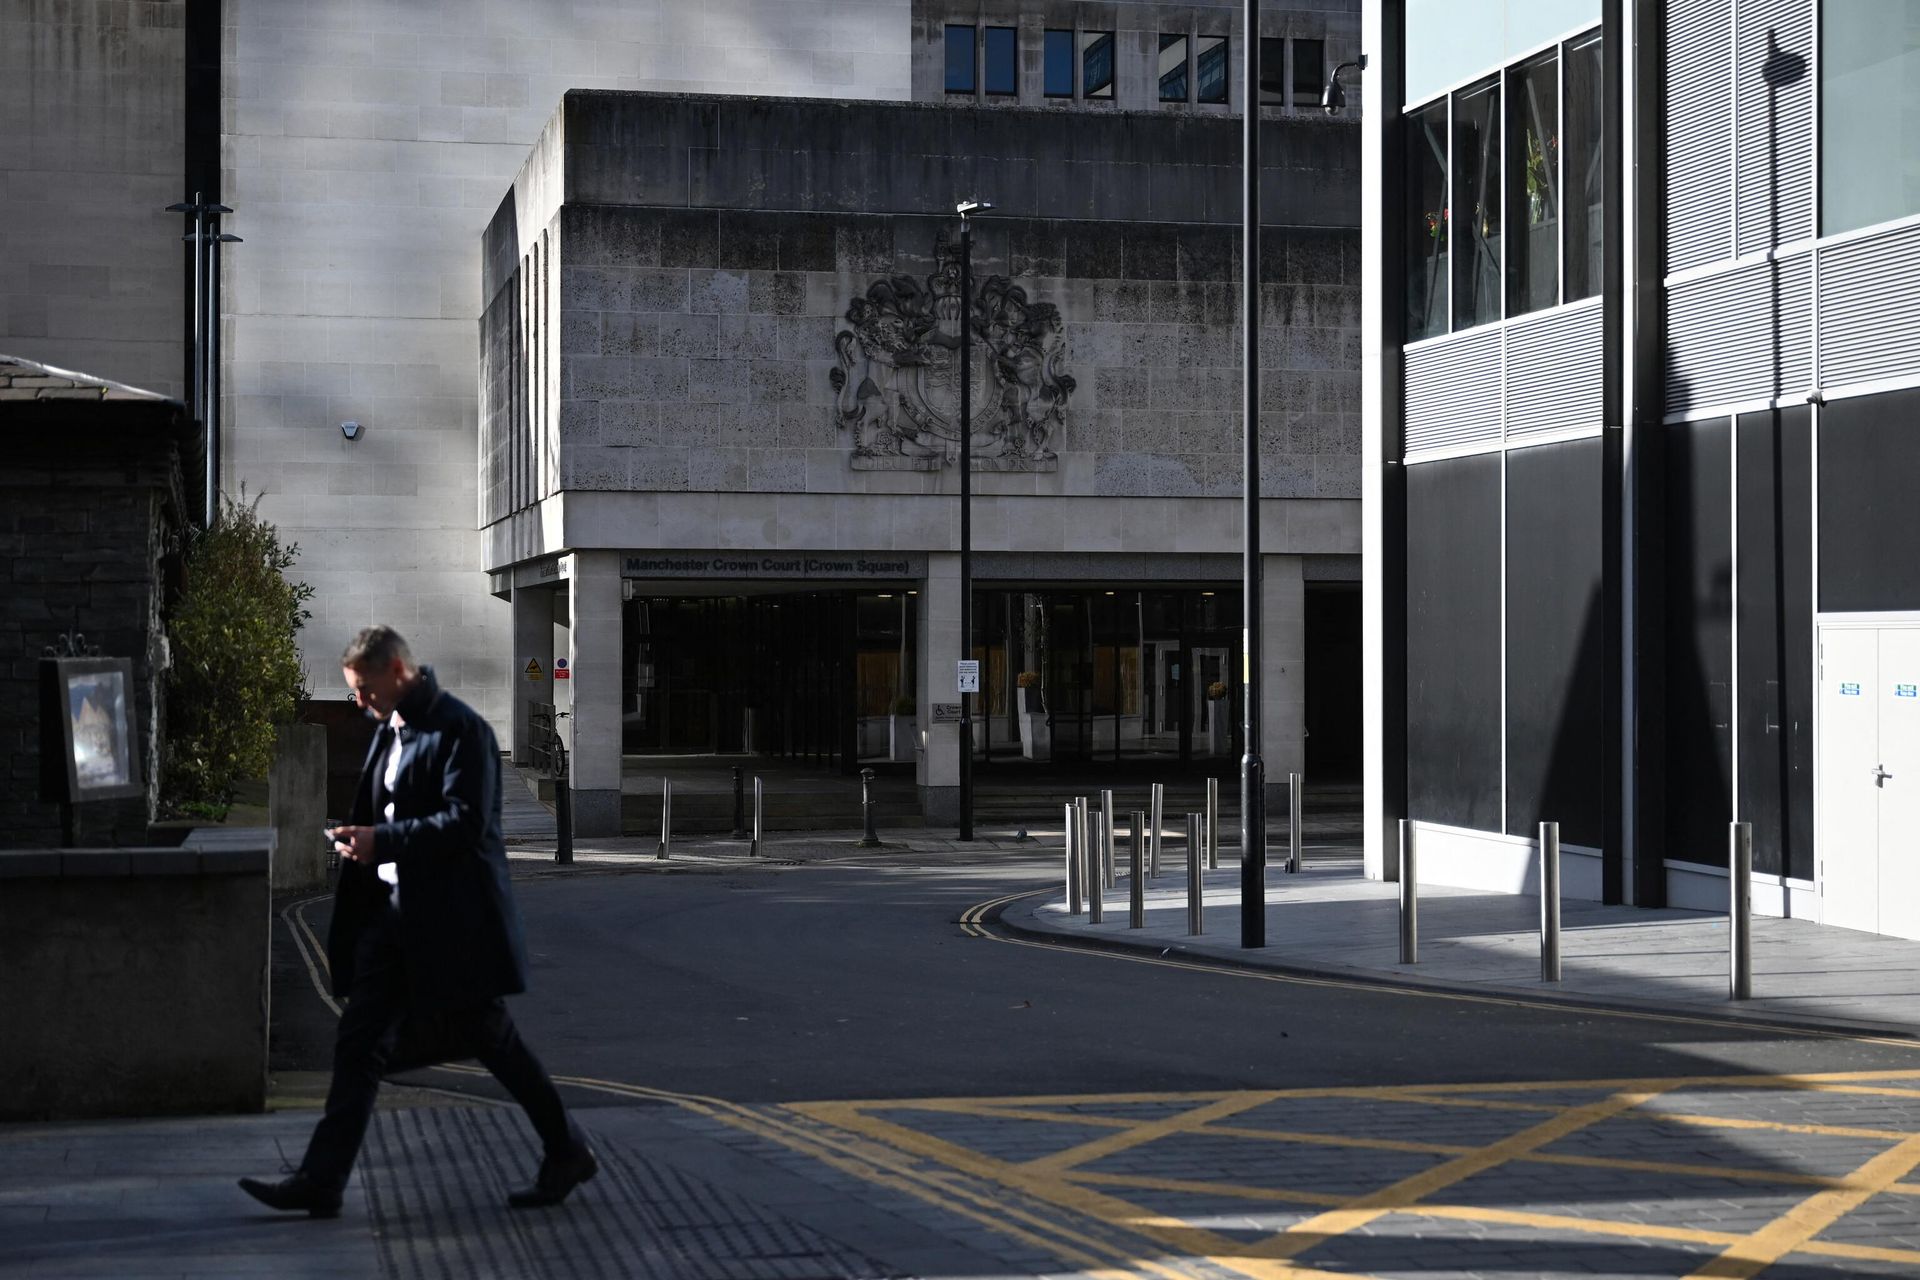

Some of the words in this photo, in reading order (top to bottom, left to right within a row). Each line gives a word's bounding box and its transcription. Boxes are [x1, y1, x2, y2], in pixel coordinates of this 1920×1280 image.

[627, 558, 709, 571] Manchester
[713, 559, 758, 571] Crown
[762, 559, 800, 572] Court
[804, 559, 852, 573] (Crown
[857, 559, 909, 573] Square)
